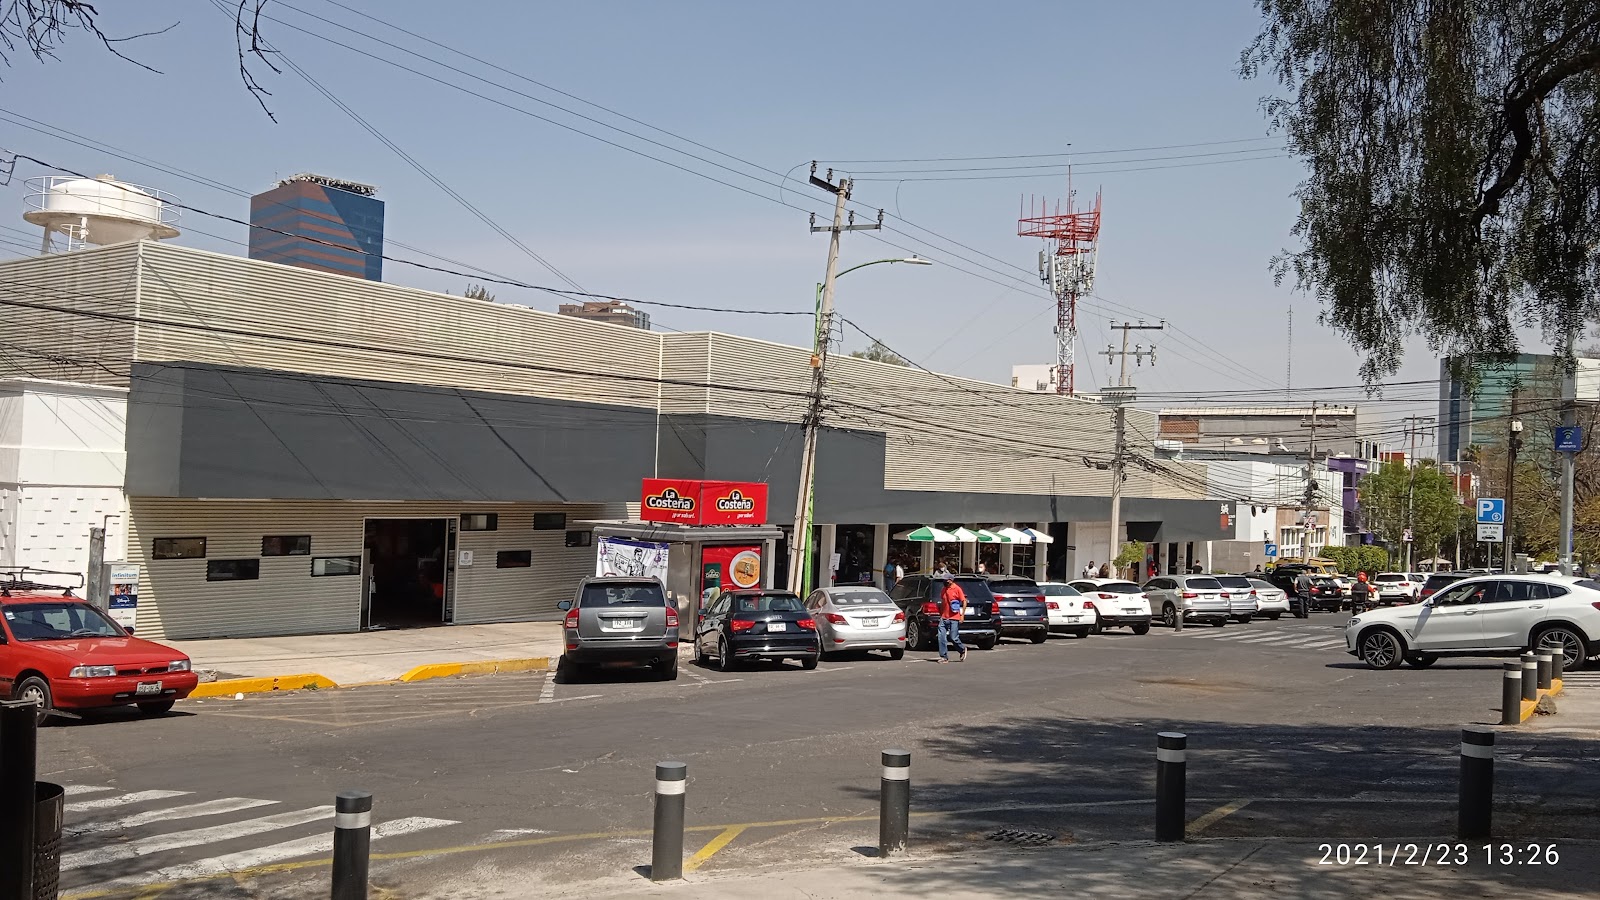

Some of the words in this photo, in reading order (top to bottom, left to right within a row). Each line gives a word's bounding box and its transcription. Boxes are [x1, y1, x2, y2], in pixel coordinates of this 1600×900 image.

[665, 490, 675, 499] La
[732, 492, 740, 500] La
[649, 497, 691, 509] Costeña
[718, 499, 751, 509] Costeña
[1478, 500, 1494, 518] P
